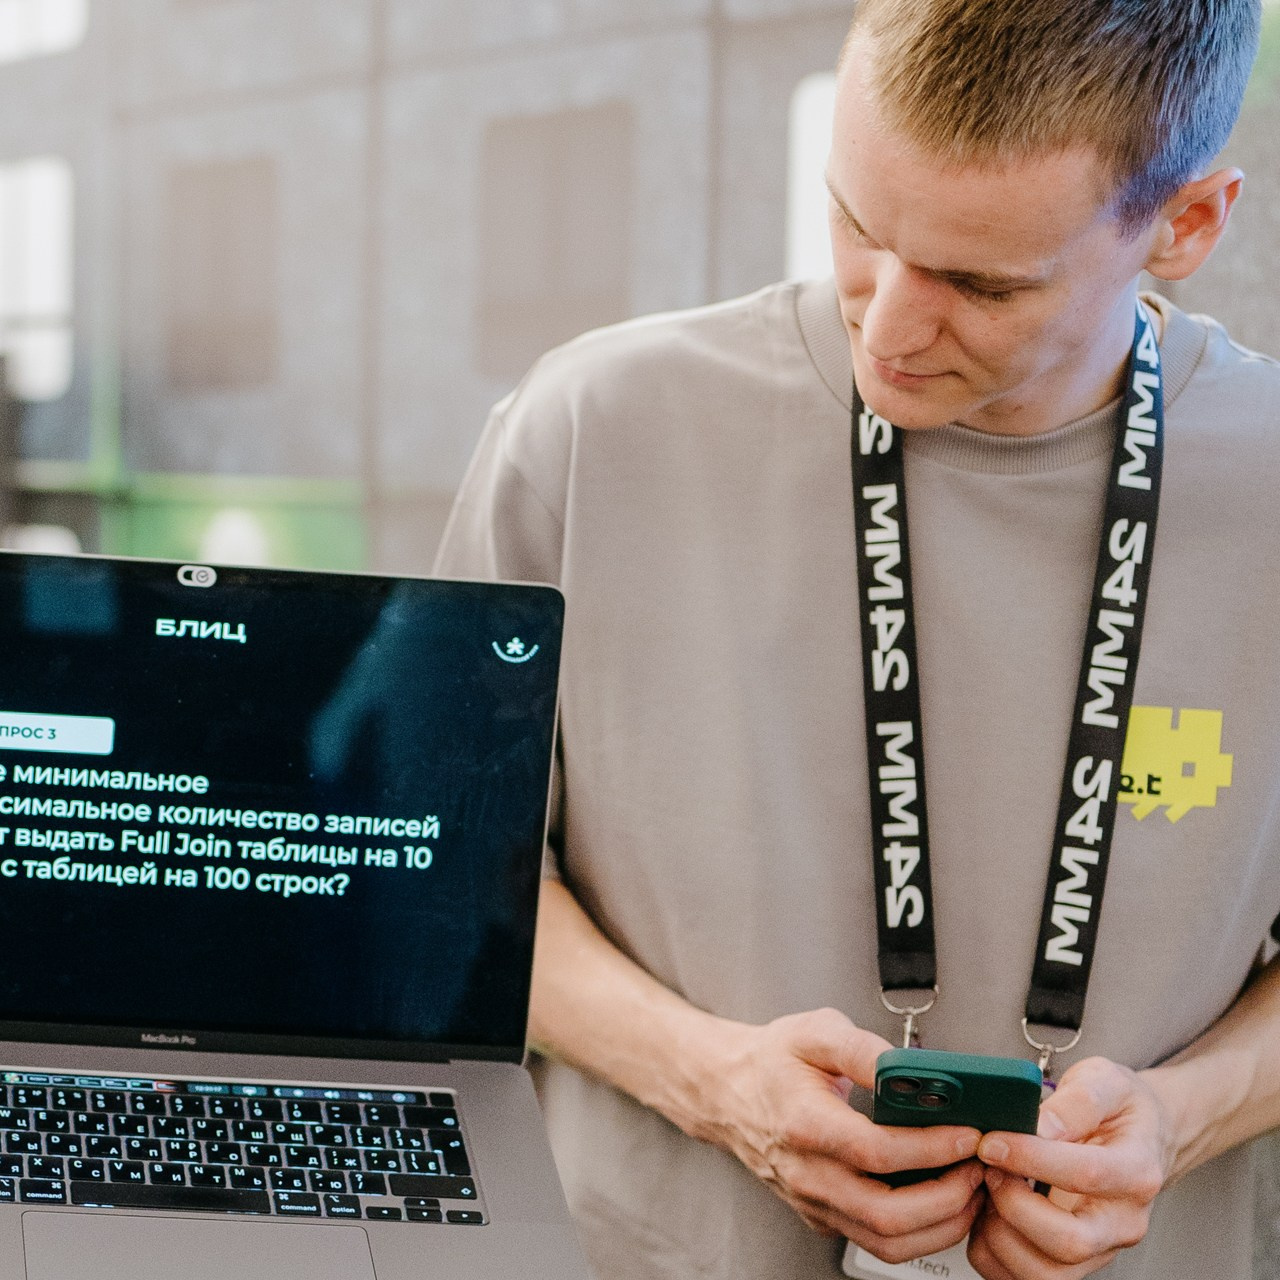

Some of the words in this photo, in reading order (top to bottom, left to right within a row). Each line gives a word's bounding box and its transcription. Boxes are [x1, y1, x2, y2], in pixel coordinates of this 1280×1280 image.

[155, 618, 247, 644] БЛИЦ
[47, 728, 57, 740] 3
[12, 764, 210, 795] минимальное
[157, 804, 320, 832] количество
[323, 814, 441, 840] записей
[14, 827, 115, 853] выдать
[120, 829, 171, 855] Full
[173, 832, 232, 859] Join
[236, 836, 359, 868] таблицы
[363, 847, 399, 868] на
[402, 845, 433, 870] 10
[0, 858, 19, 878] с
[21, 855, 158, 887] таблицей
[163, 867, 199, 888] на
[203, 865, 251, 891] 100
[255, 872, 351, 898] строк?
[280, 1204, 317, 1212] command
